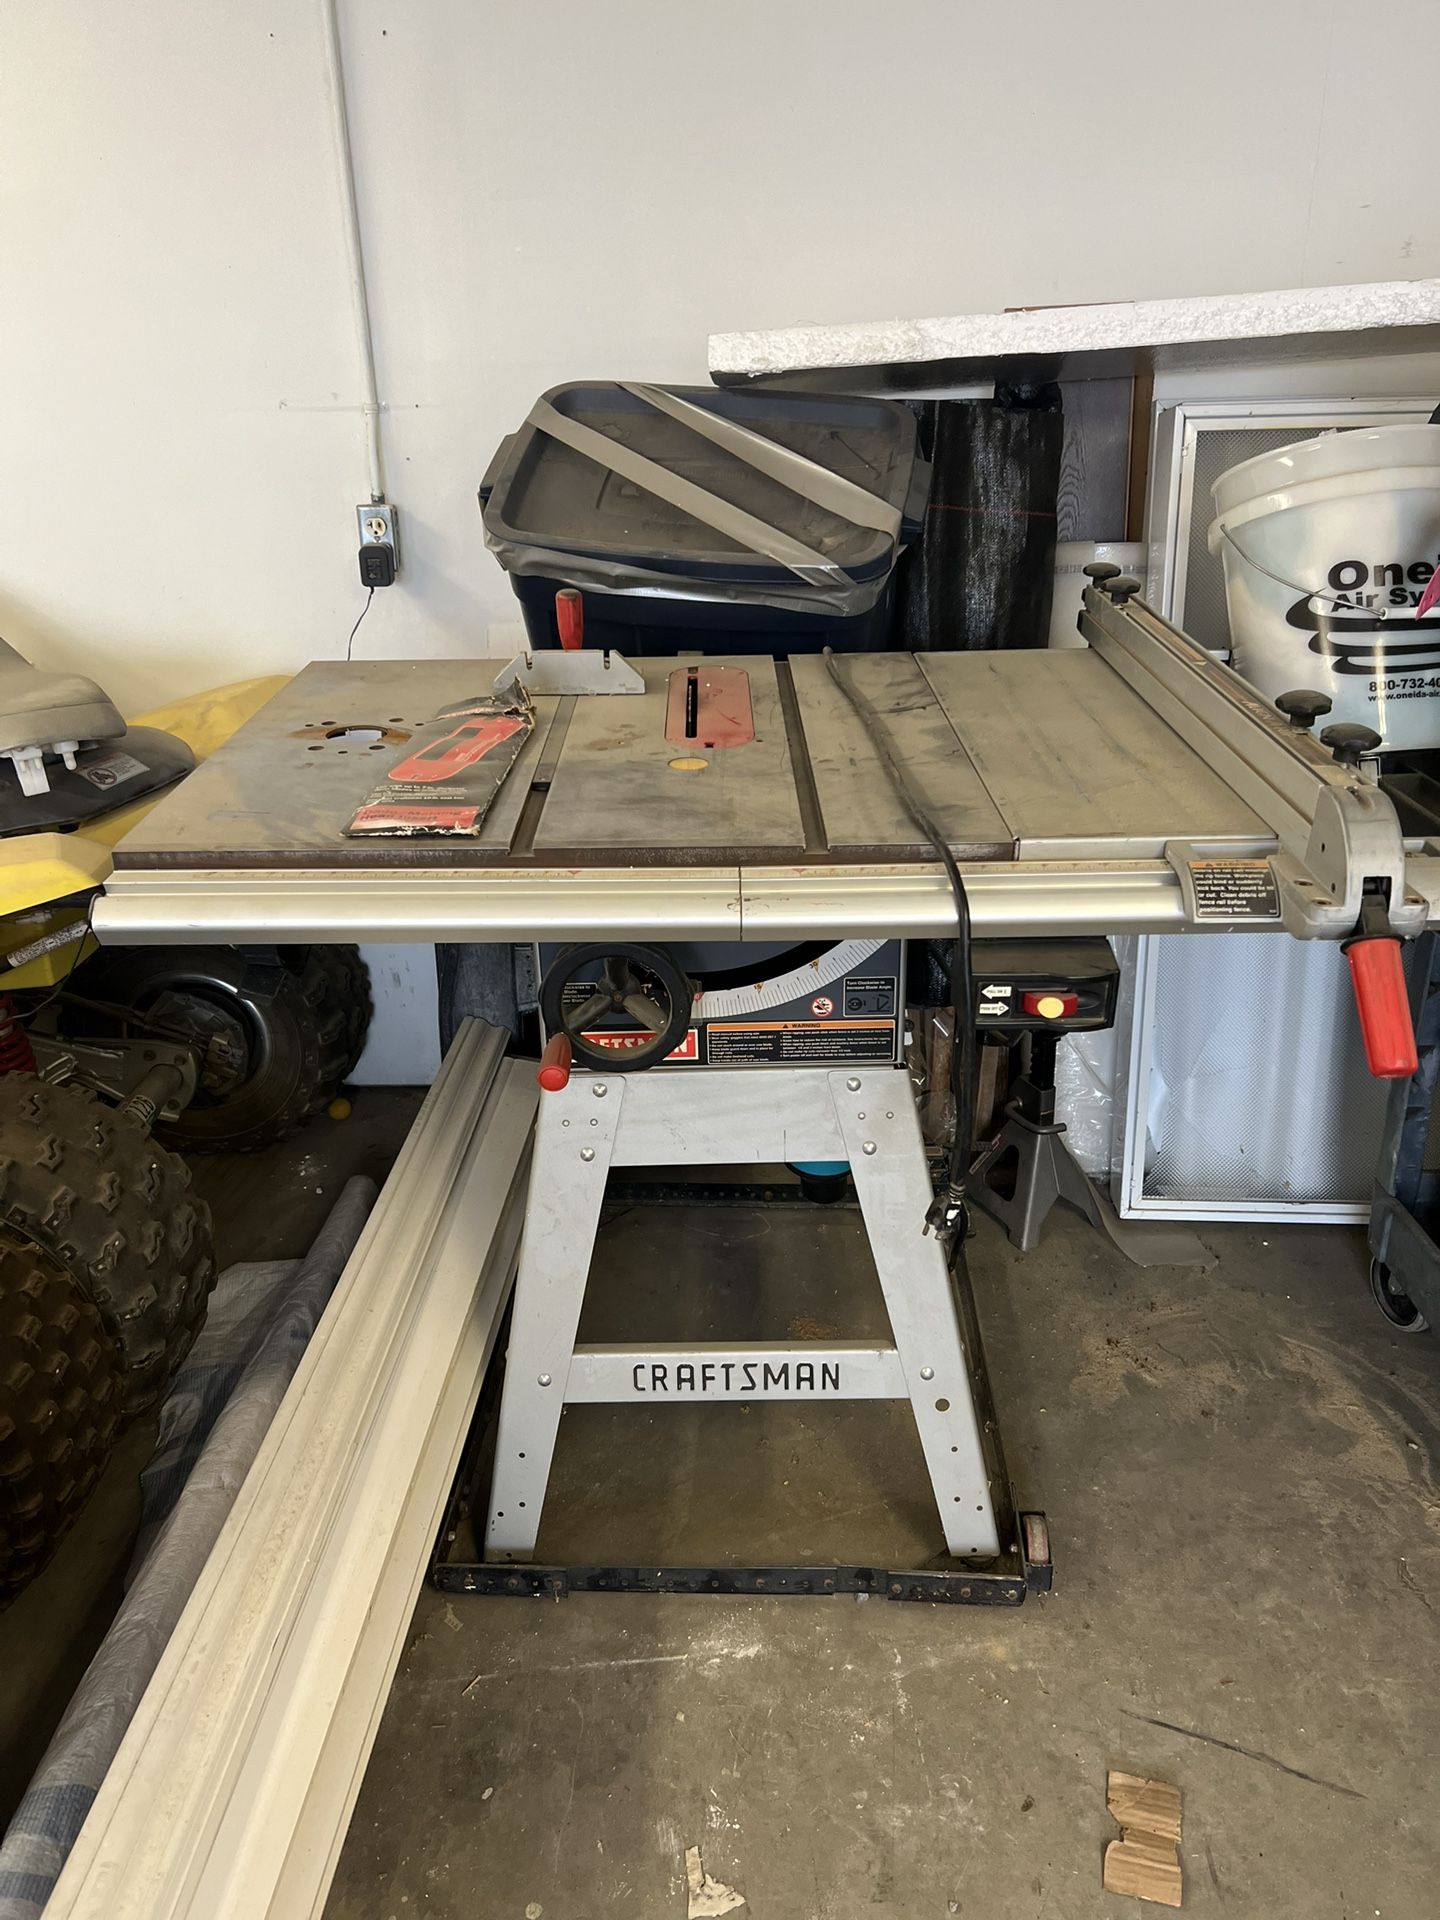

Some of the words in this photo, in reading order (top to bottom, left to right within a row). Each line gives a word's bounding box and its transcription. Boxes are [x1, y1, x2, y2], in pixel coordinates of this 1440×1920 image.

[1328, 556, 1440, 591] One
[1331, 591, 1379, 612] Air
[809, 960, 820, 969] 30
[633, 1362, 839, 1391] CRAFTSMAN
